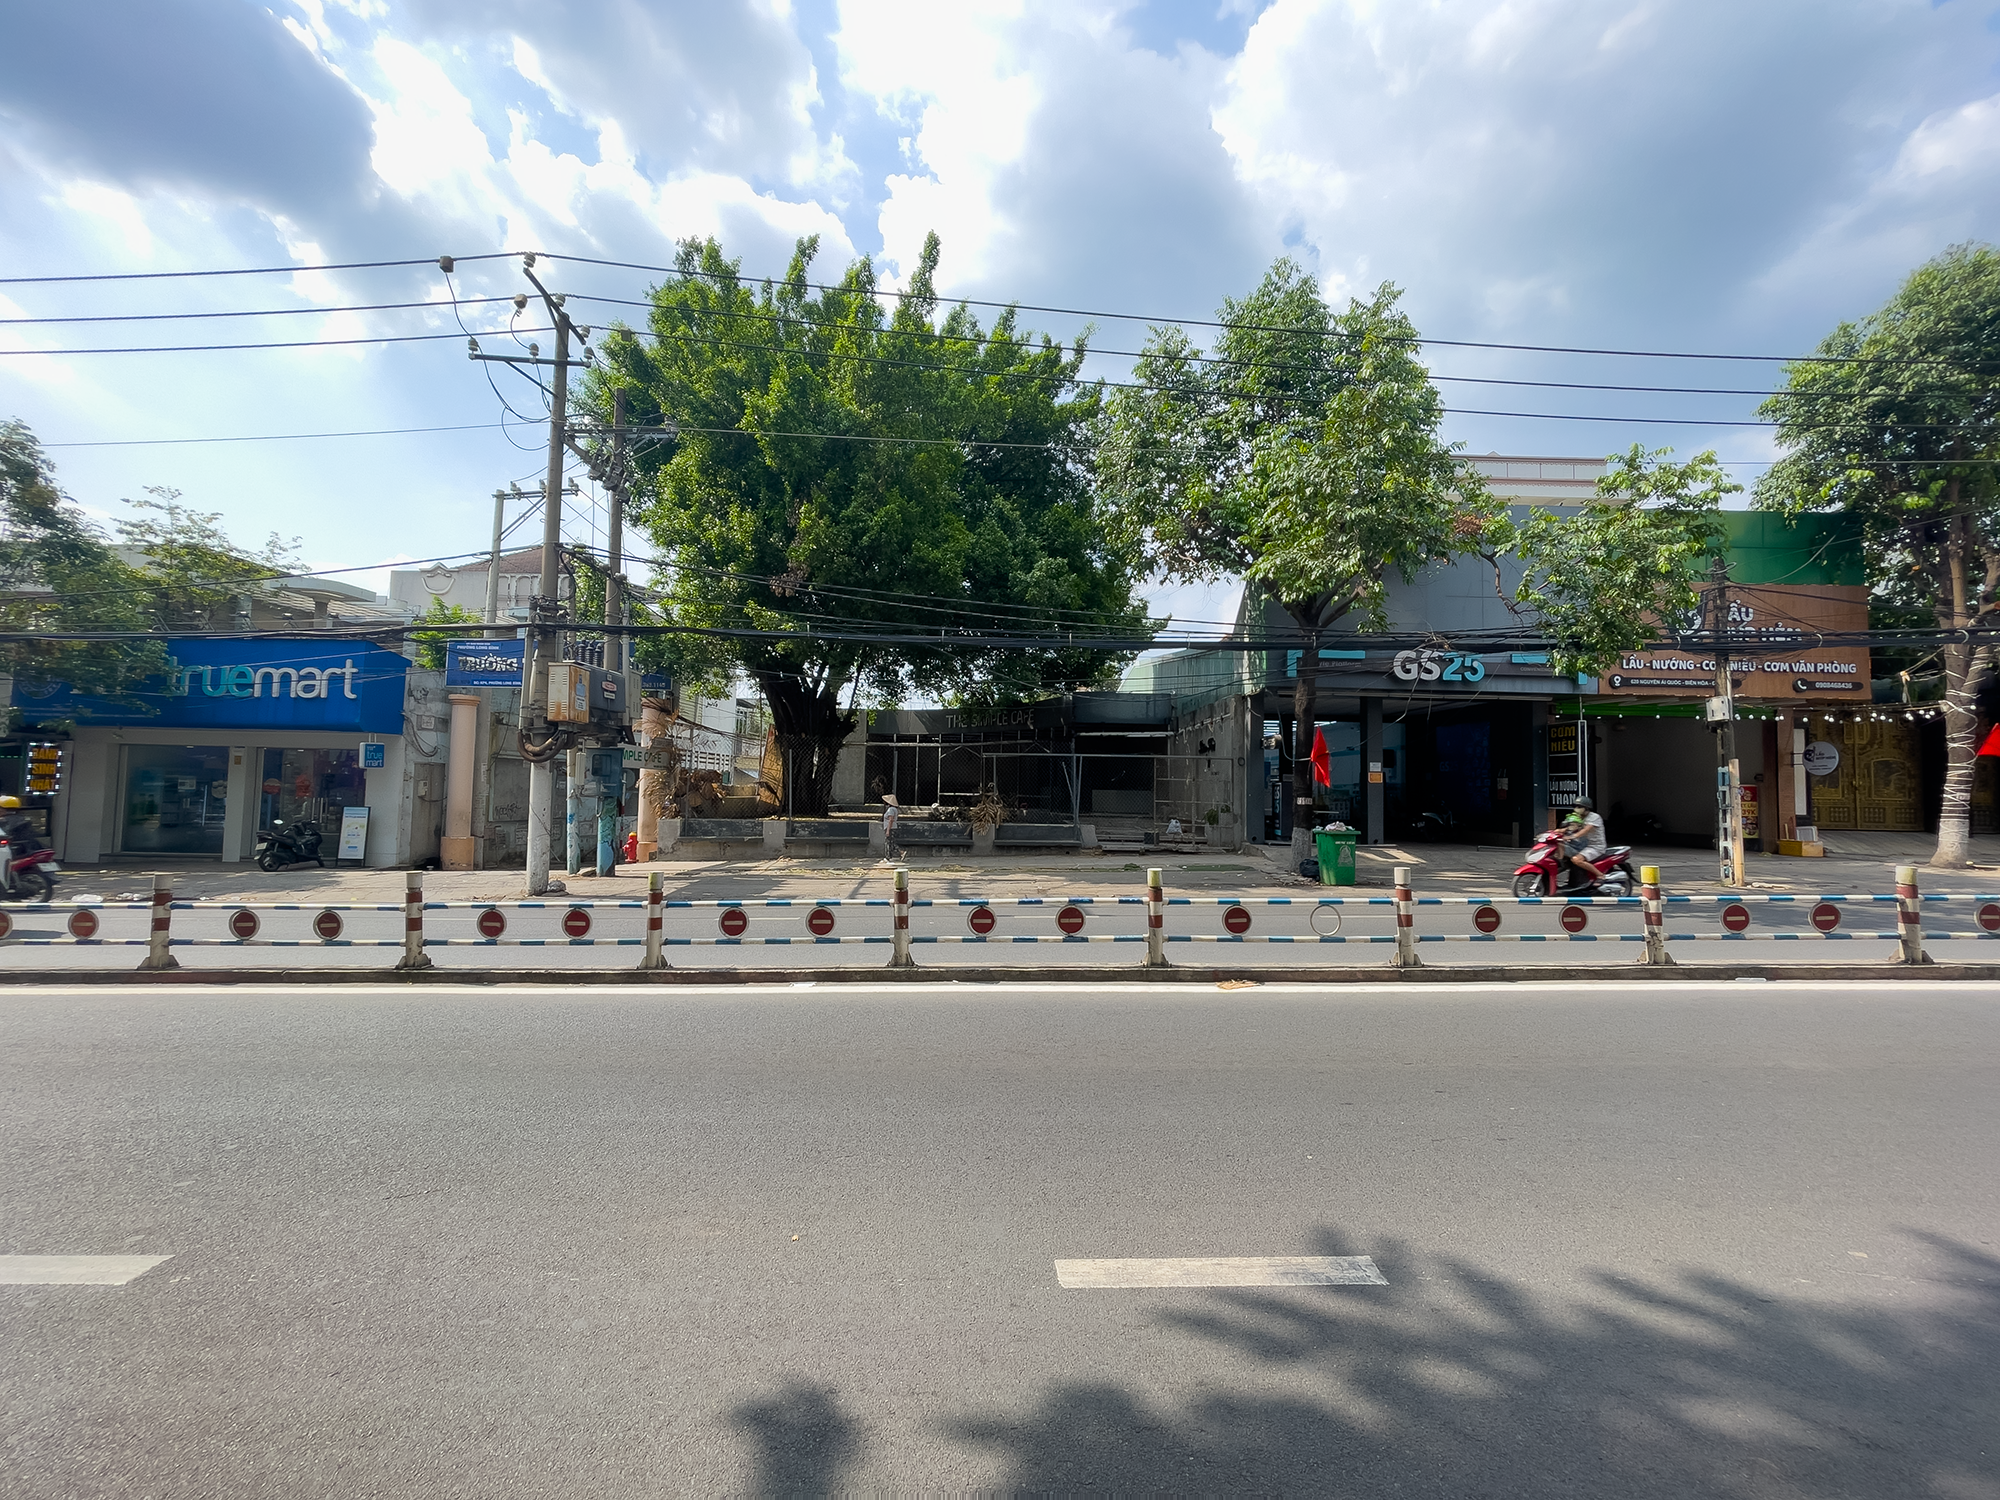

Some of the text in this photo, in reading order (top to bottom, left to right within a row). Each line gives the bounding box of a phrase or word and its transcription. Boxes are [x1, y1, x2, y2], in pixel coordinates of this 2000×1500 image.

[1727, 599, 1754, 621] ẨU
[458, 653, 518, 671] TRƯỜNG
[1393, 649, 1485, 681] GS25
[1622, 654, 1644, 669] LẨU
[1652, 657, 1695, 670] NƯỚNG
[1764, 661, 1789, 672] CƠM
[1792, 660, 1814, 673] VĂN
[1817, 660, 1857, 673] PHÒNG
[167, 656, 358, 699] truemart
[366, 751, 383, 759] true
[1551, 793, 1576, 805] THAN
